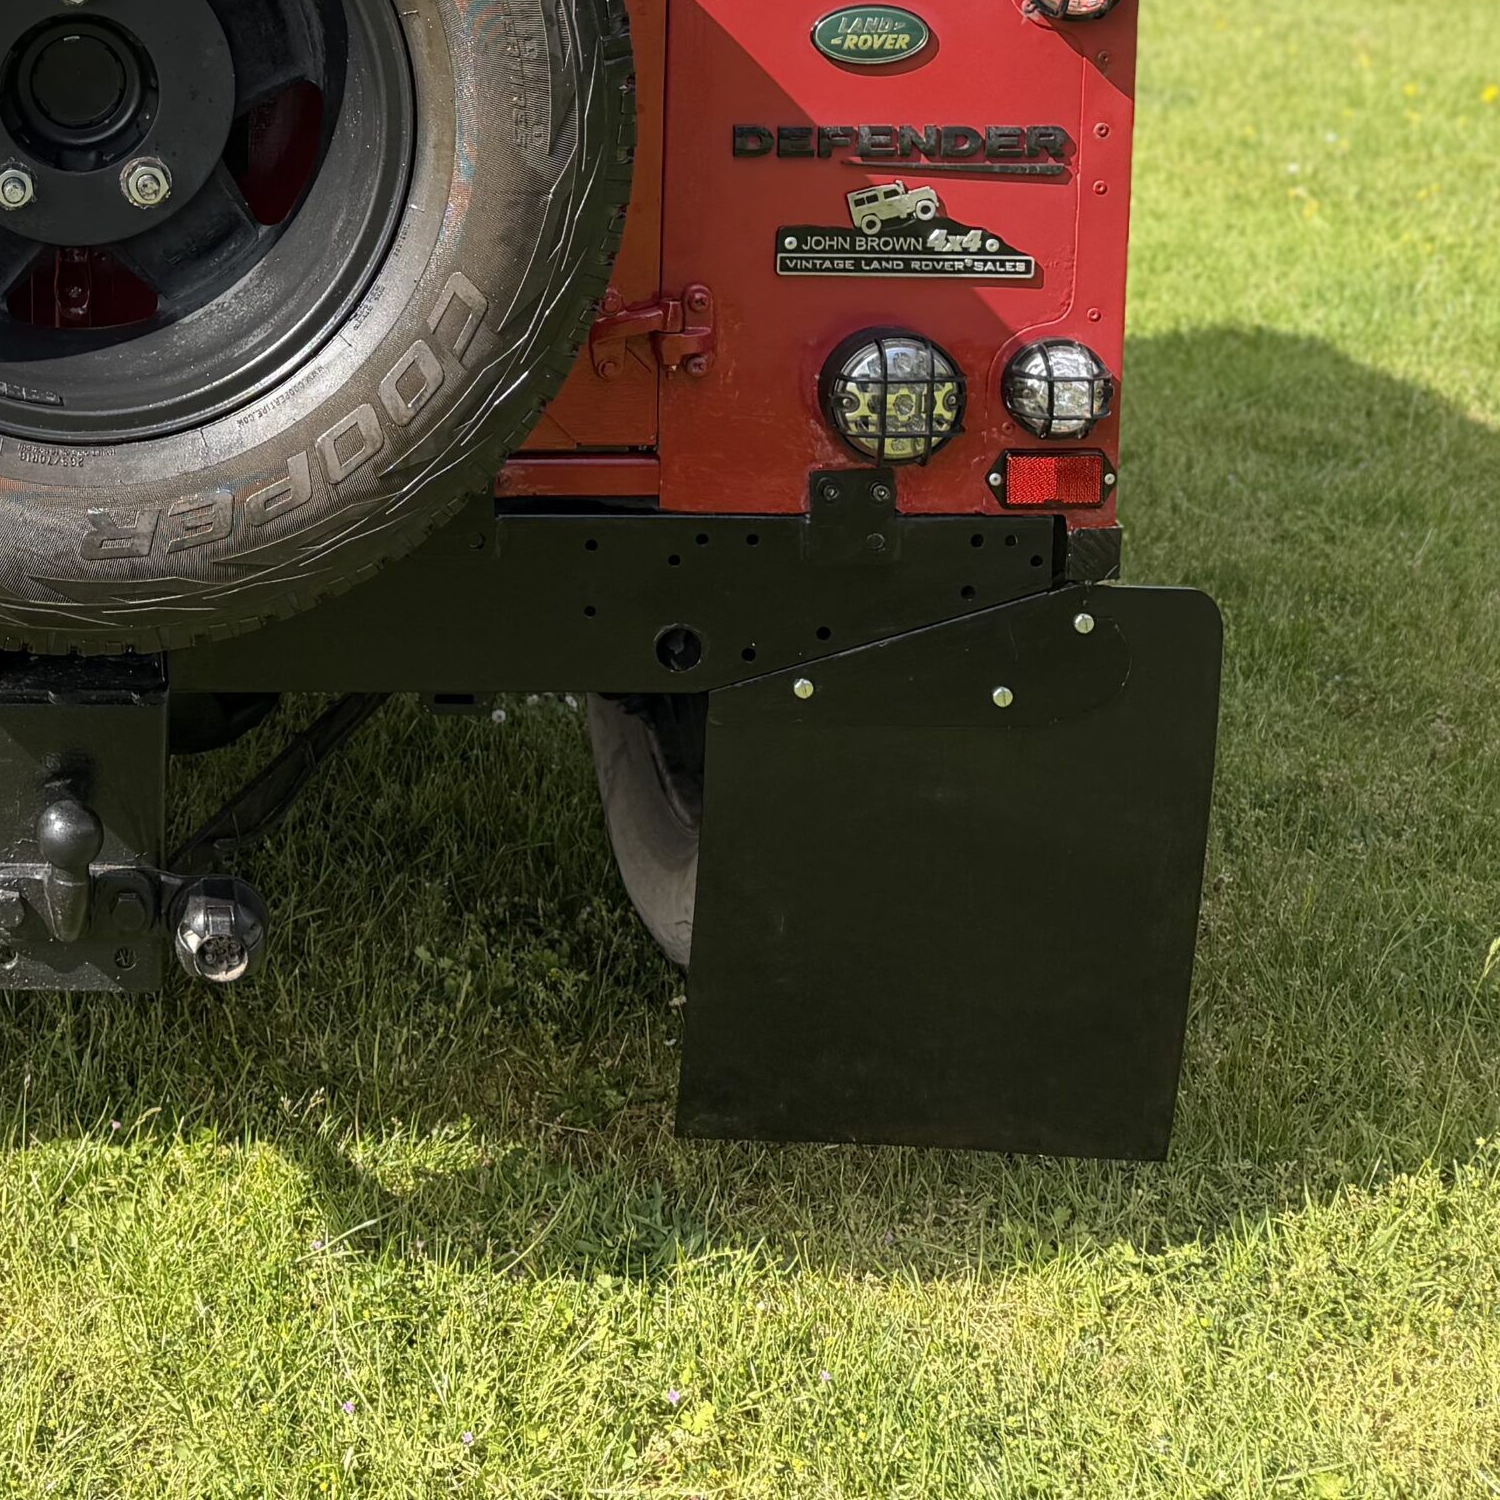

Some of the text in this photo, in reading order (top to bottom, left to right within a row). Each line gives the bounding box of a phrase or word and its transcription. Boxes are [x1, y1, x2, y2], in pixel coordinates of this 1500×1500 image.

[837, 16, 895, 34] LAND
[842, 34, 911, 51] ROVER
[732, 124, 1073, 159] DEFENDER
[801, 228, 983, 252] JOHN BROWN 4x4
[786, 259, 855, 271] VINTAGE
[861, 259, 904, 271] LAND
[973, 261, 1026, 273] SALES
[80, 271, 490, 561] COOPER
